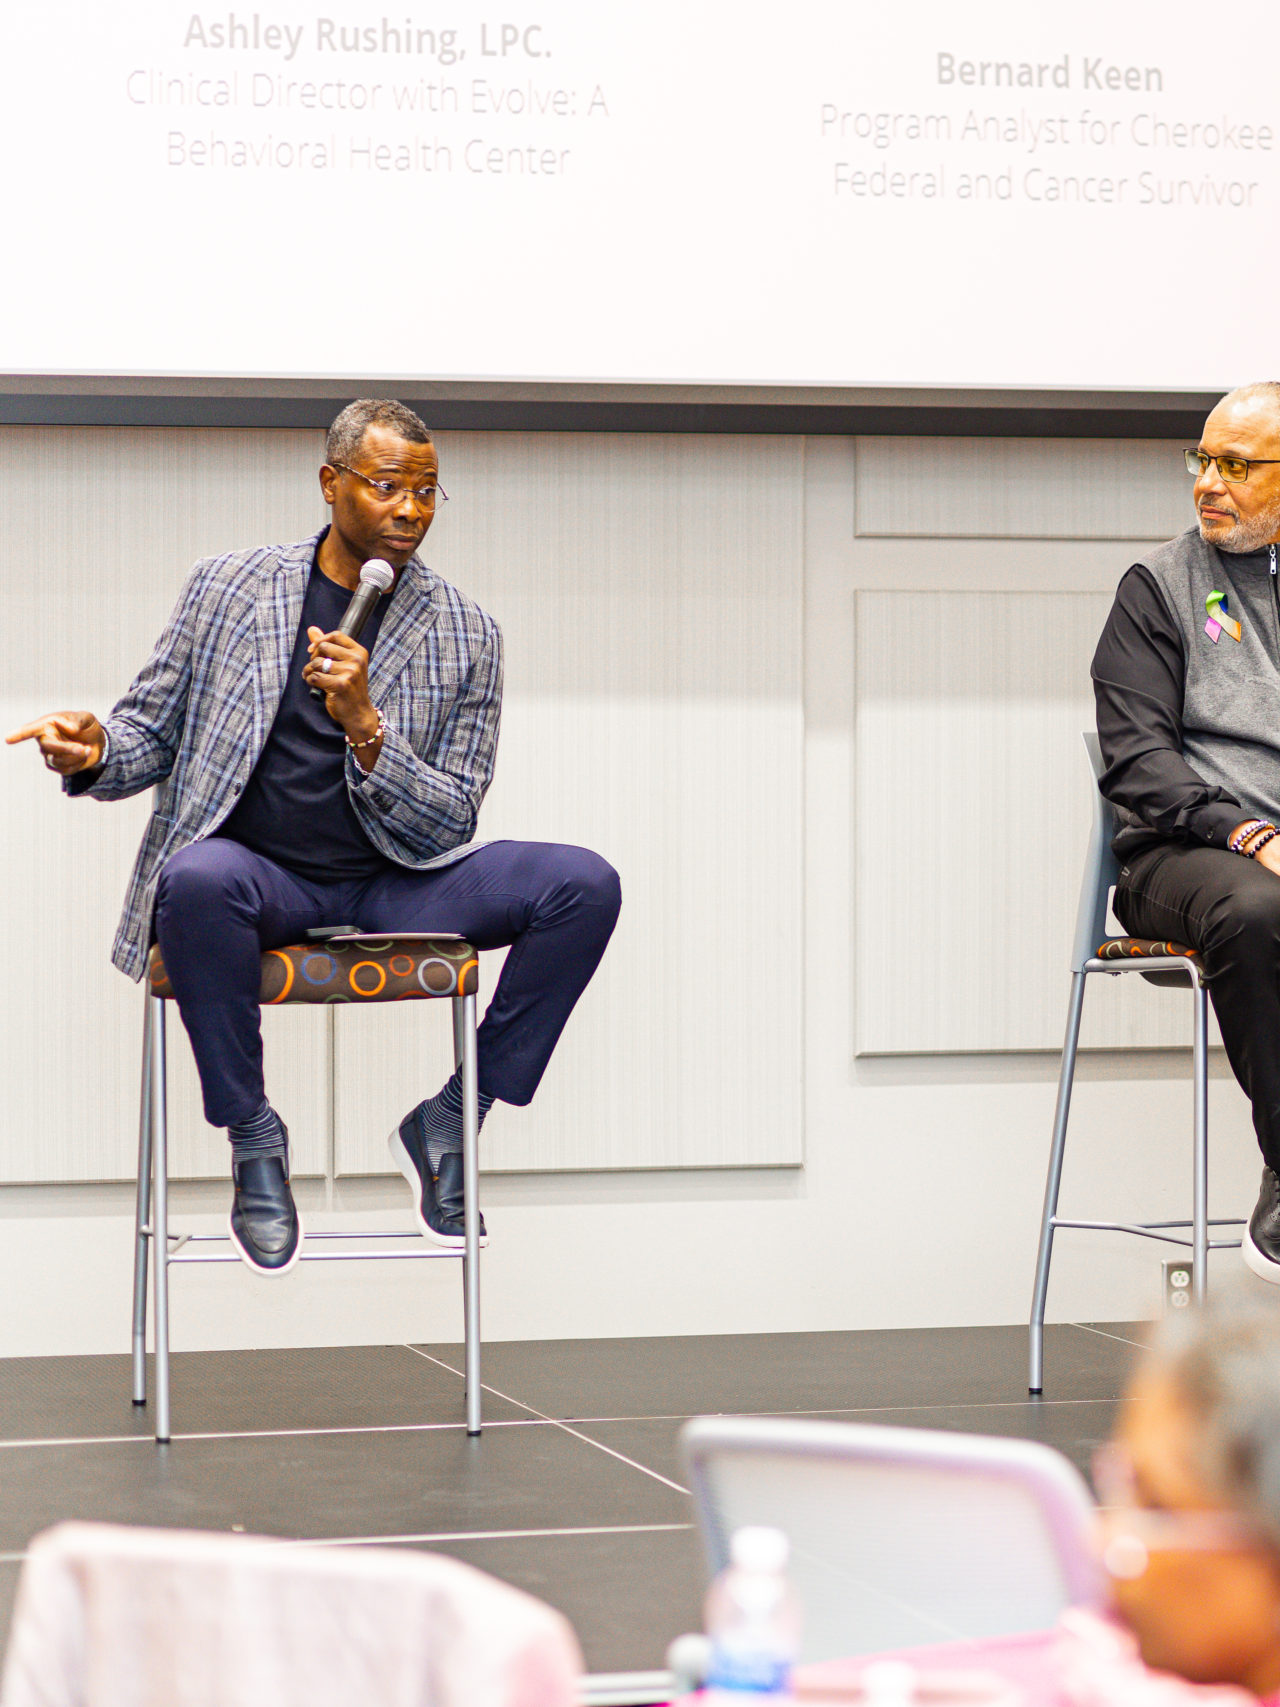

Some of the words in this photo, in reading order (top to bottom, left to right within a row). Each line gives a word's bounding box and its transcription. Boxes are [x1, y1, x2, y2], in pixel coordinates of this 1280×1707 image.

[183, 12, 302, 60] Ashley
[317, 17, 466, 65] Rushing,
[480, 23, 553, 58] LPC.
[126, 68, 238, 106] Clinical
[252, 70, 382, 110] Director
[392, 75, 459, 113] with
[472, 79, 577, 116] Evolve:
[587, 84, 610, 117] A
[937, 51, 1071, 89] Bernard
[1083, 57, 1164, 92] Keen
[820, 104, 952, 149] Program
[961, 108, 1070, 153] Analyst
[1078, 110, 1121, 145] for
[1131, 113, 1274, 150] Cherokee
[167, 130, 335, 169] Behavioral
[350, 135, 452, 173] Health
[464, 138, 571, 175] Center
[833, 162, 945, 199] Federal
[956, 166, 1013, 202] and
[1024, 168, 1129, 204] Cancer
[1138, 172, 1259, 207] Survivor
